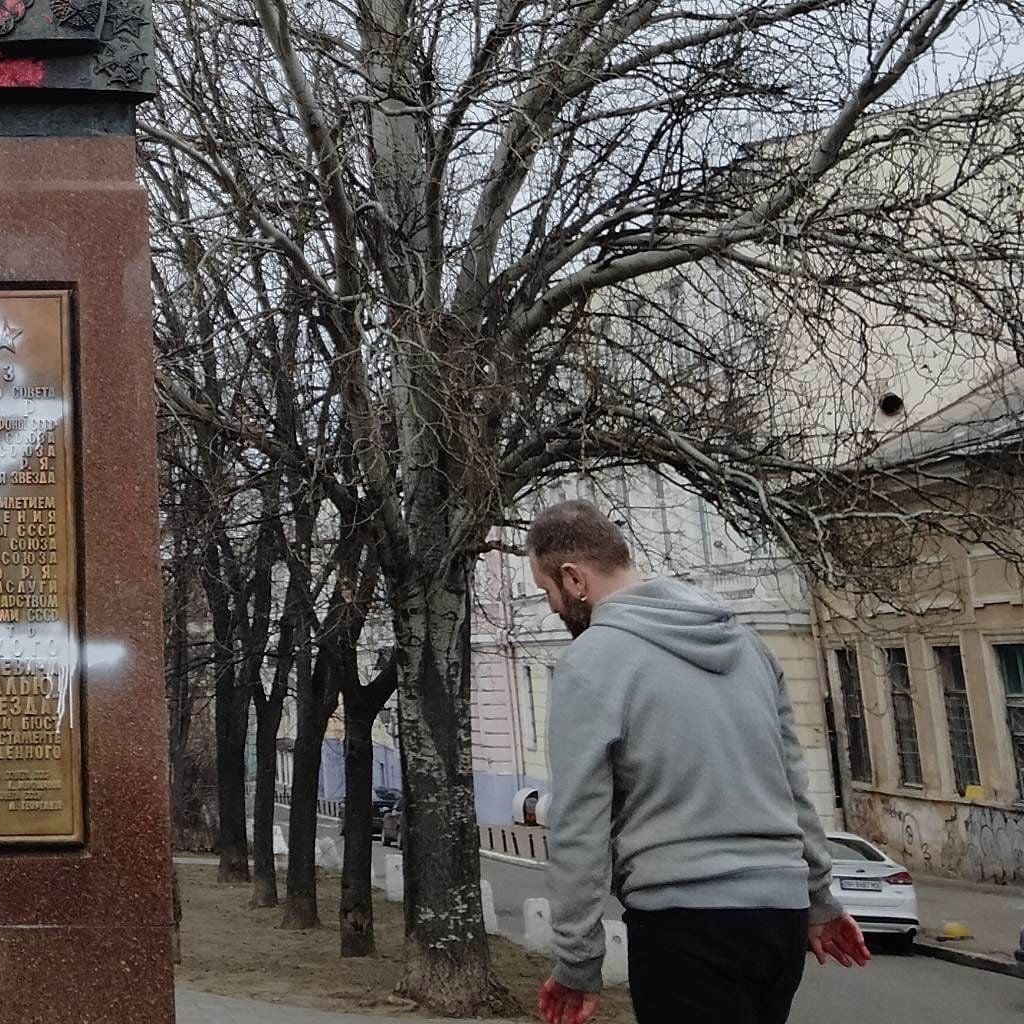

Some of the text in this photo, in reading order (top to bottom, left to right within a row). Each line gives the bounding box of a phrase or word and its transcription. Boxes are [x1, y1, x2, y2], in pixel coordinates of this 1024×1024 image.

[12, 386, 55, 399] СОВЕТА
[6, 432, 56, 445] СОЮЗА
[0, 445, 56, 458] СОЮЗА
[11, 472, 55, 484] ЗВЕЗДА
[17, 525, 56, 537] СССР
[10, 538, 56, 551] СОЮЗА
[1, 551, 57, 565] СОЮЗА
[42, 566, 57, 579] Я.
[28, 609, 58, 622] СССР
[22, 716, 59, 731] БЮСТ
